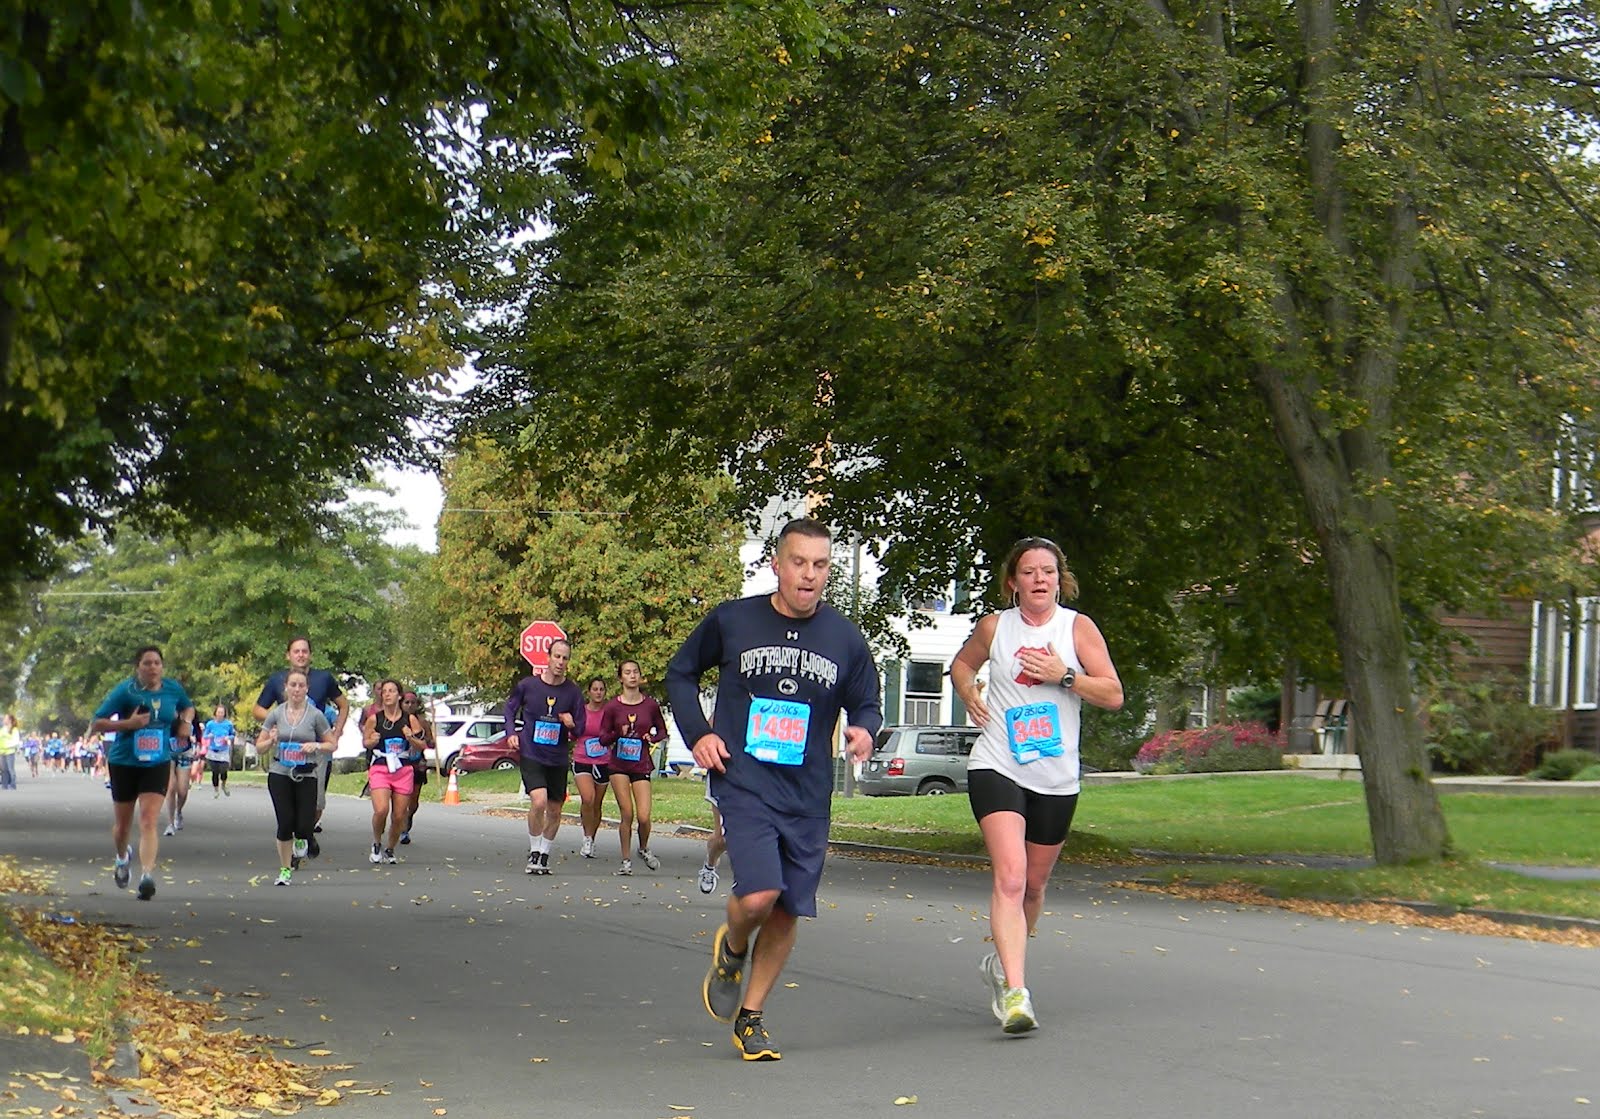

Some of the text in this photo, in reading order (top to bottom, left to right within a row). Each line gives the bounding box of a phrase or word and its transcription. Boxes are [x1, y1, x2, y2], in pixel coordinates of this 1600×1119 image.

[523, 635, 561, 653] STO
[740, 646, 838, 686] NITTANY LIONS
[746, 666, 831, 690] PENN STATE
[752, 713, 806, 743] 1495
[1014, 716, 1053, 743] 345
